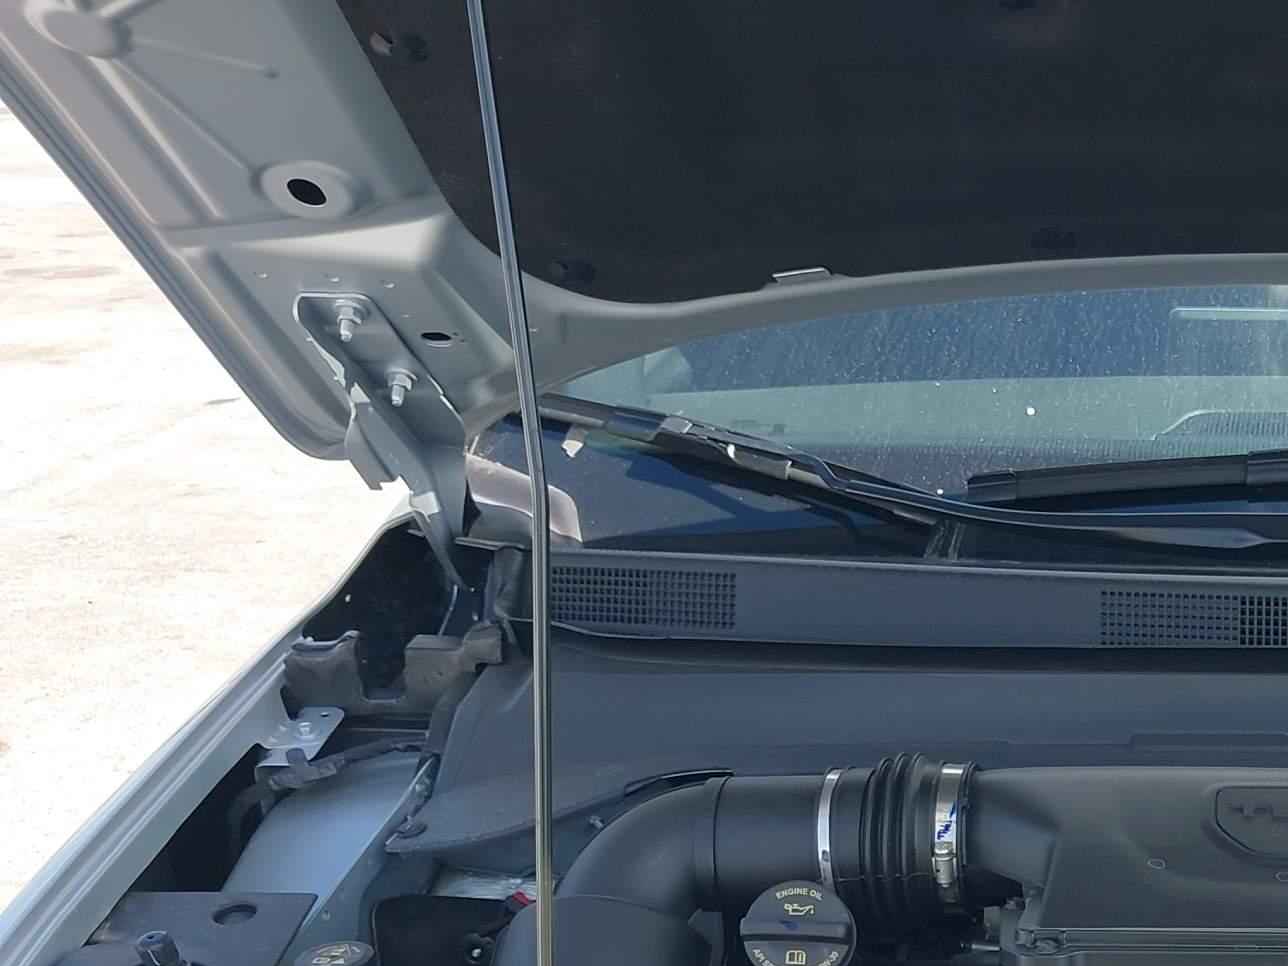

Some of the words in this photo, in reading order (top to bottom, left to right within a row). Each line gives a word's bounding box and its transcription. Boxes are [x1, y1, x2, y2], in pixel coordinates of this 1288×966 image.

[775, 887, 808, 900] ENGINE
[809, 889, 824, 901] OIL
[752, 948, 765, 963] API
